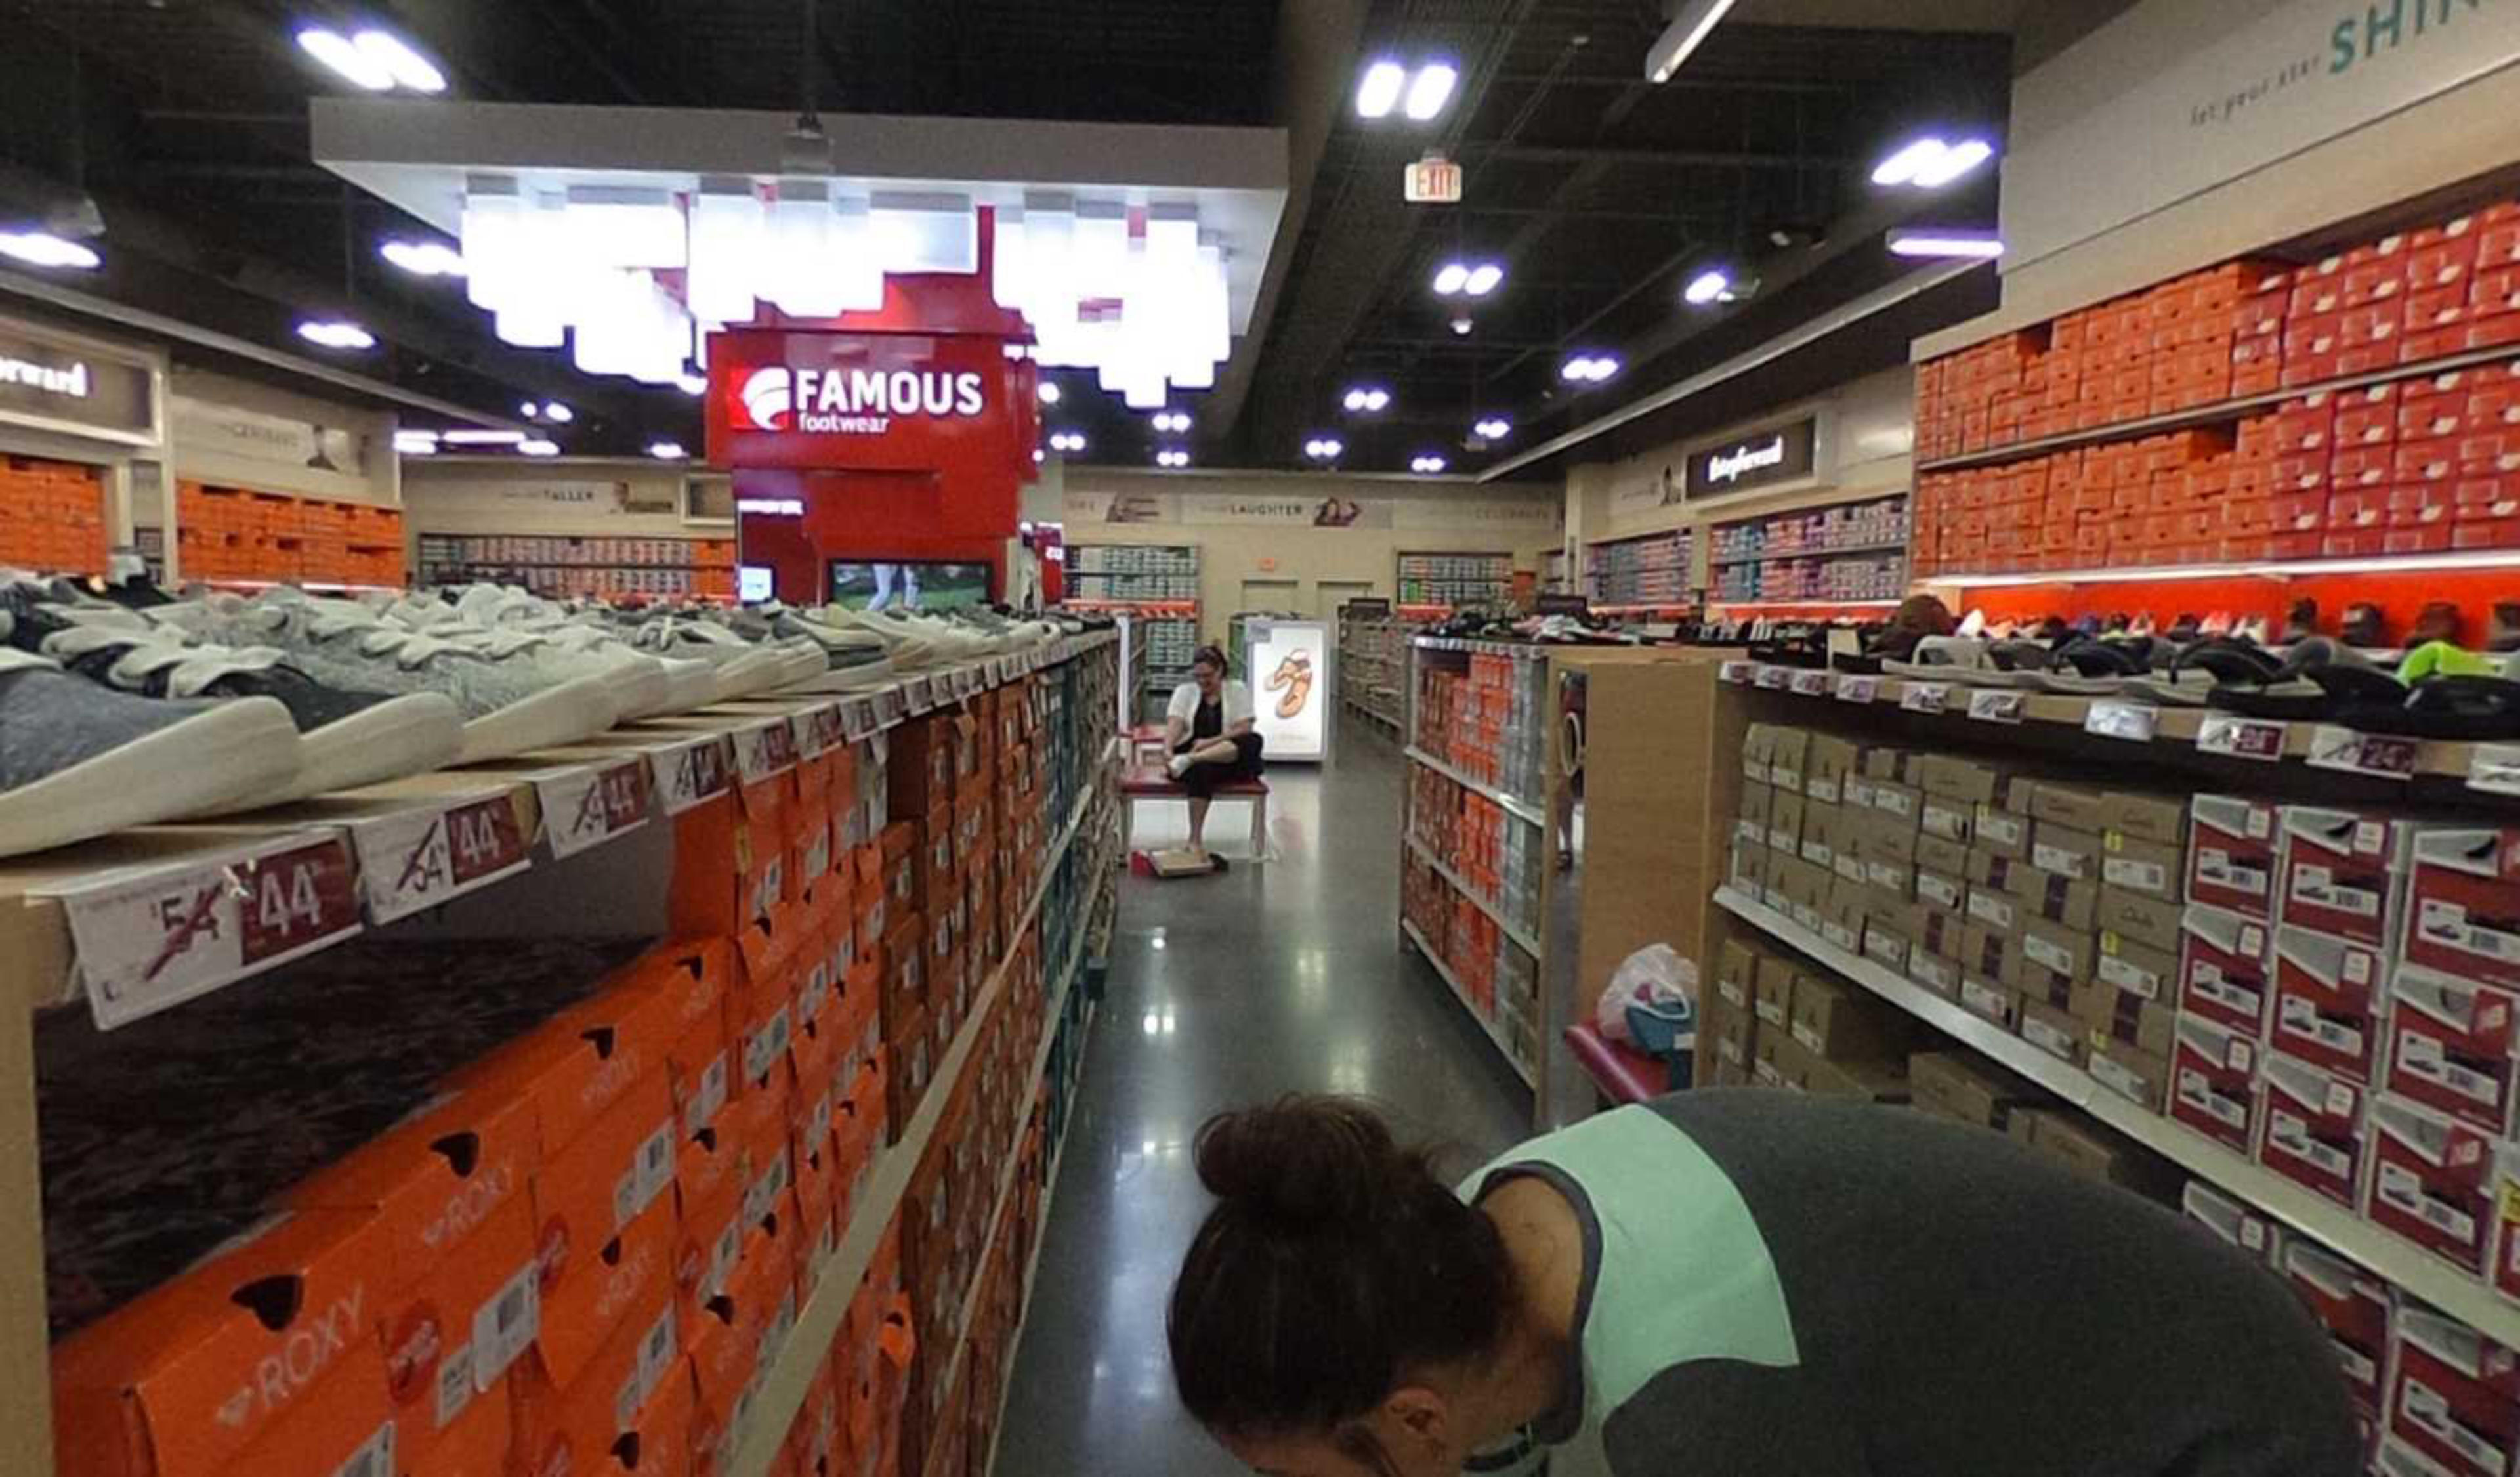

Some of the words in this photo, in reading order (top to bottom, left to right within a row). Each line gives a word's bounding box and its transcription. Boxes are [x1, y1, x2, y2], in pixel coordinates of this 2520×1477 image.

[2328, 0, 2479, 74] SHI
[1416, 167, 1454, 197] EXIT
[795, 369, 983, 415] FAMOUS
[799, 413, 890, 433] footwear
[1230, 504, 1302, 516] LAUGHTER
[259, 862, 322, 936] 44
[253, 1282, 364, 1408] ROXY
